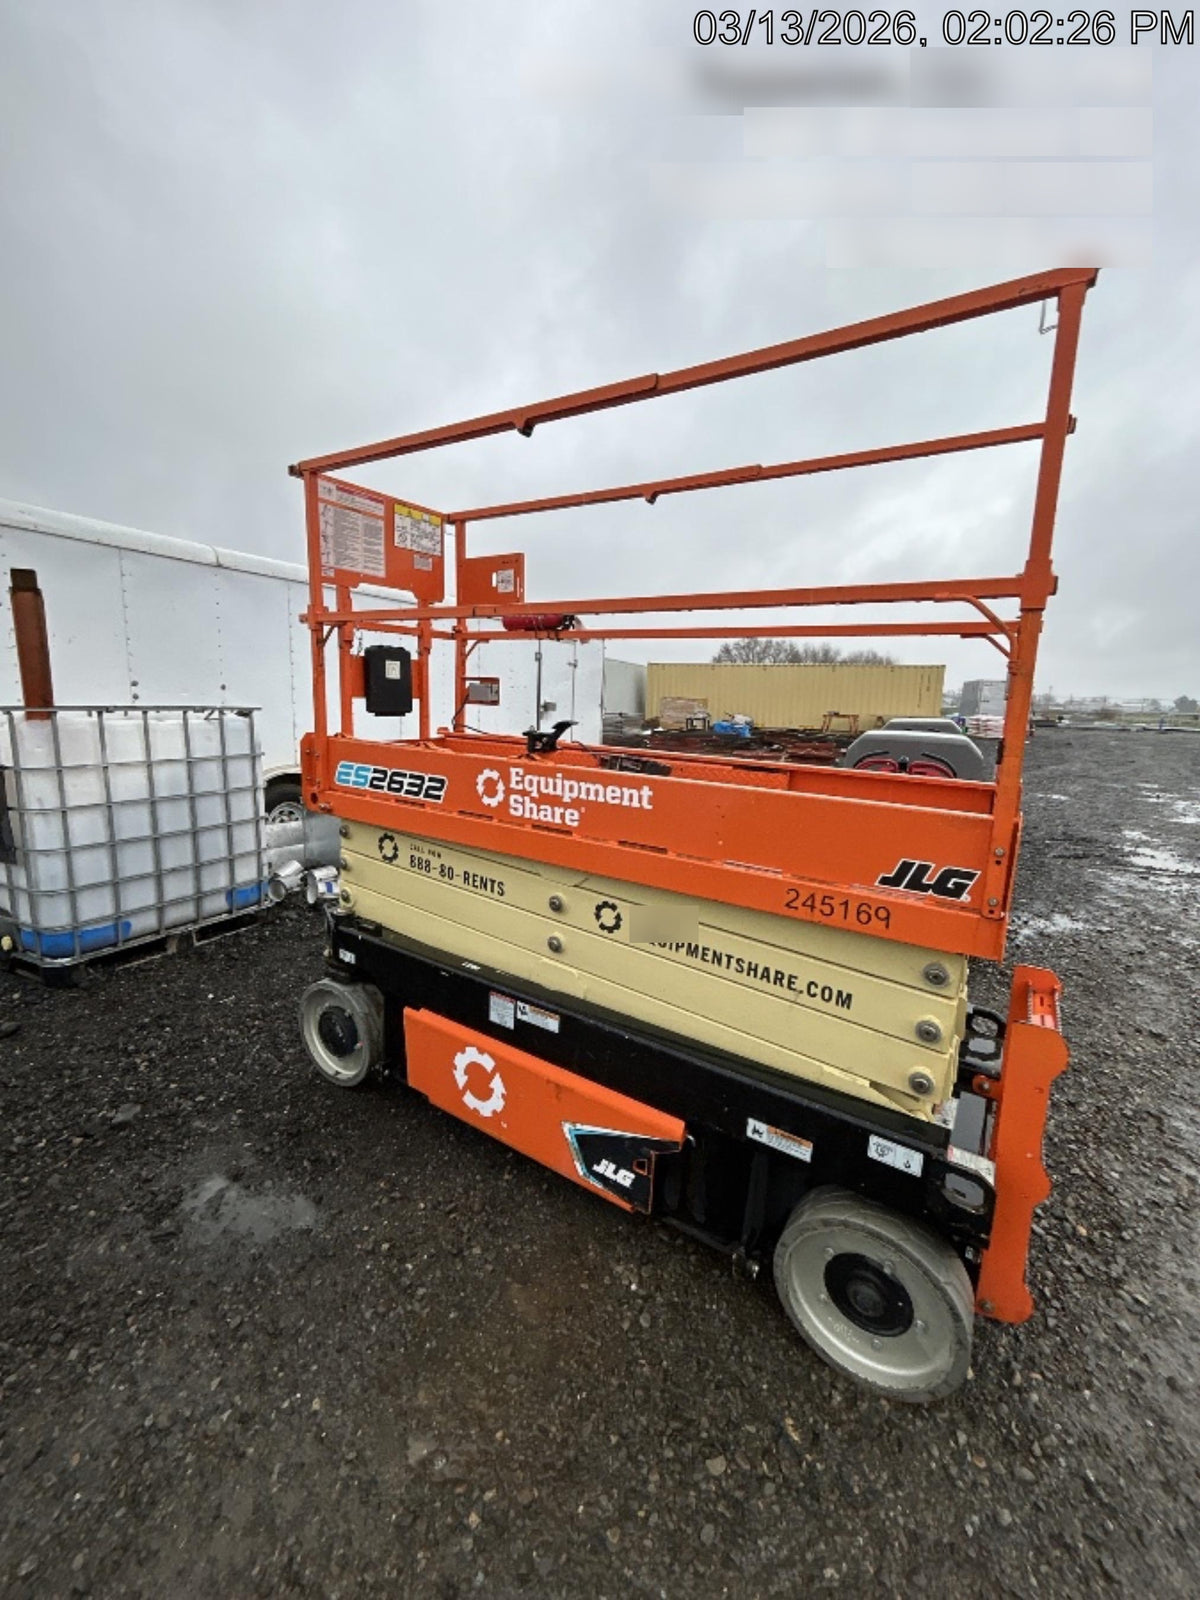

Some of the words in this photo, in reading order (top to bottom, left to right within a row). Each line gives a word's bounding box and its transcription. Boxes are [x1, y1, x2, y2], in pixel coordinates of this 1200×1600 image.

[335, 761, 447, 802] ES2632
[509, 767, 653, 809] Equipment
[509, 795, 580, 827] Share
[410, 854, 505, 897] 888-80-RENTS
[876, 859, 980, 902] JLG
[785, 888, 891, 929] 245169
[592, 1158, 636, 1188] JLG
